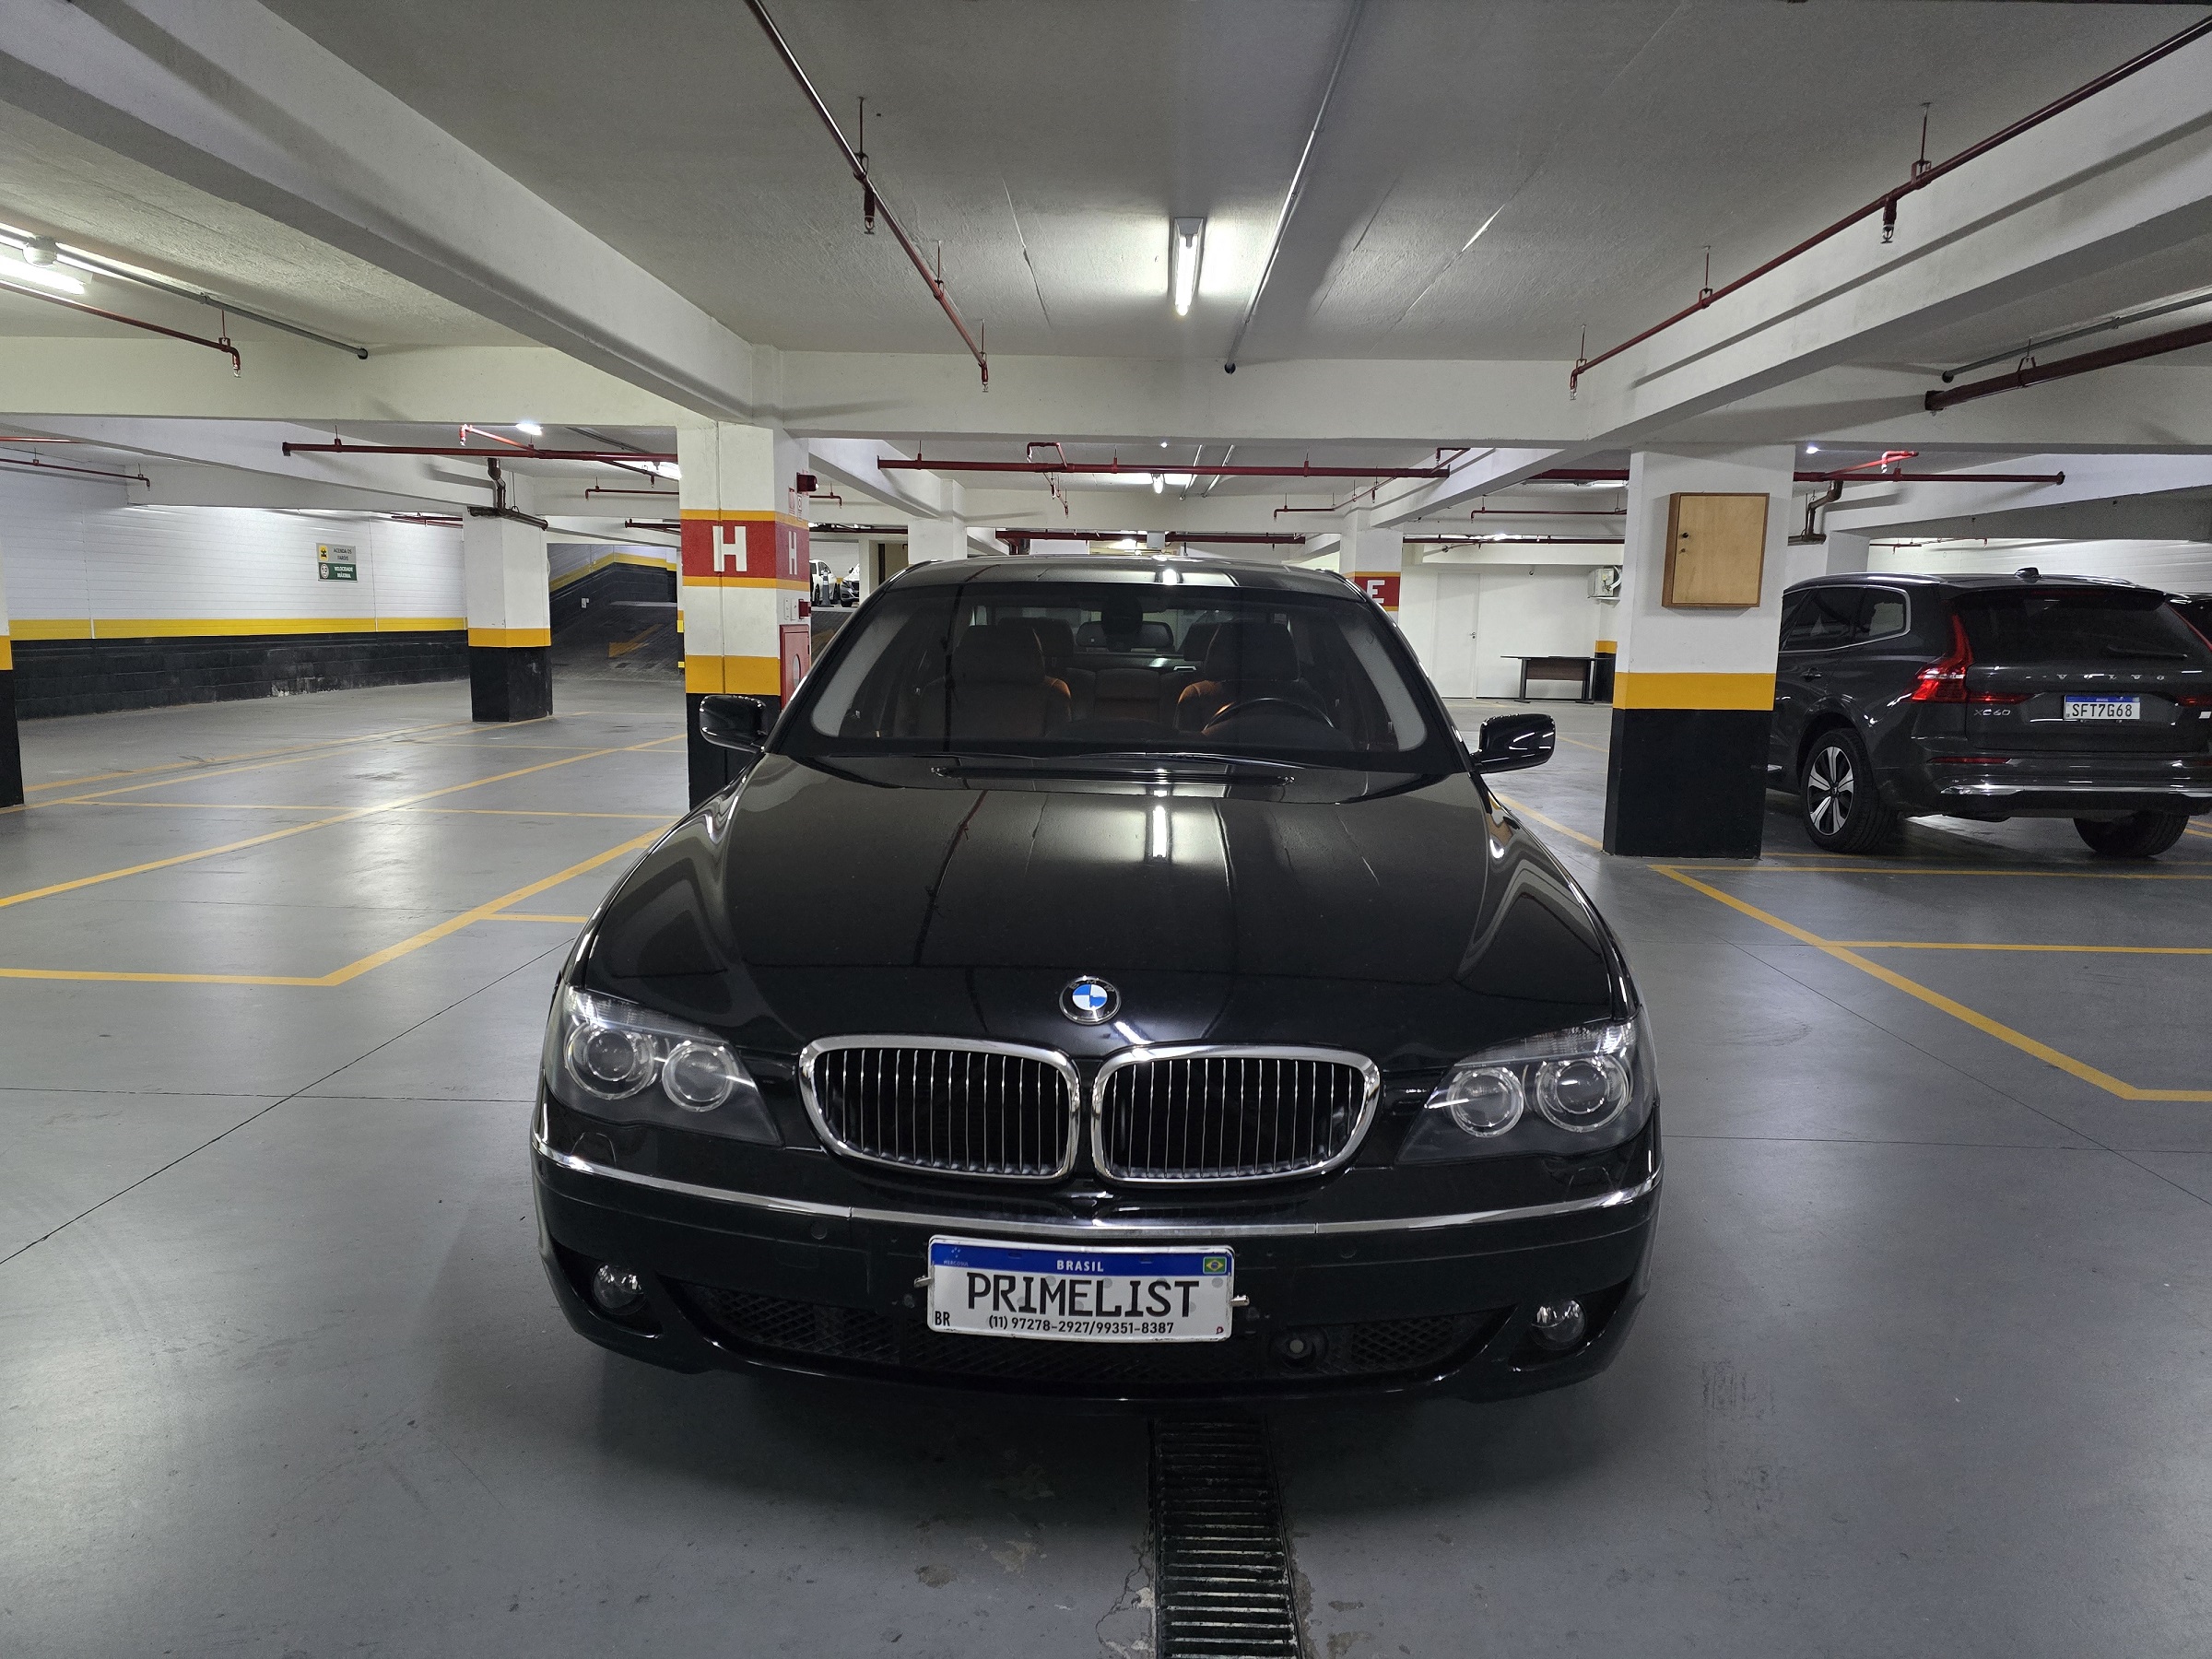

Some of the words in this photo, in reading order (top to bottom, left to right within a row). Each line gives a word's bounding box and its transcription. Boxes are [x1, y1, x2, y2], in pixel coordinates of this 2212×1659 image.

[712, 525, 747, 572] H
[788, 531, 798, 575] H
[1366, 580, 1385, 604] E
[1973, 708, 2011, 717] XC60
[2072, 703, 2133, 717] SFT7G68
[1069, 979, 1115, 993] BMW
[1056, 1259, 1105, 1273] BRASIL
[966, 1272, 1200, 1318] PRIMELIST
[935, 1311, 950, 1327] BR
[989, 1315, 1008, 1330] (11)
[1011, 1315, 1175, 1335] 97278-2927/99351-8387
